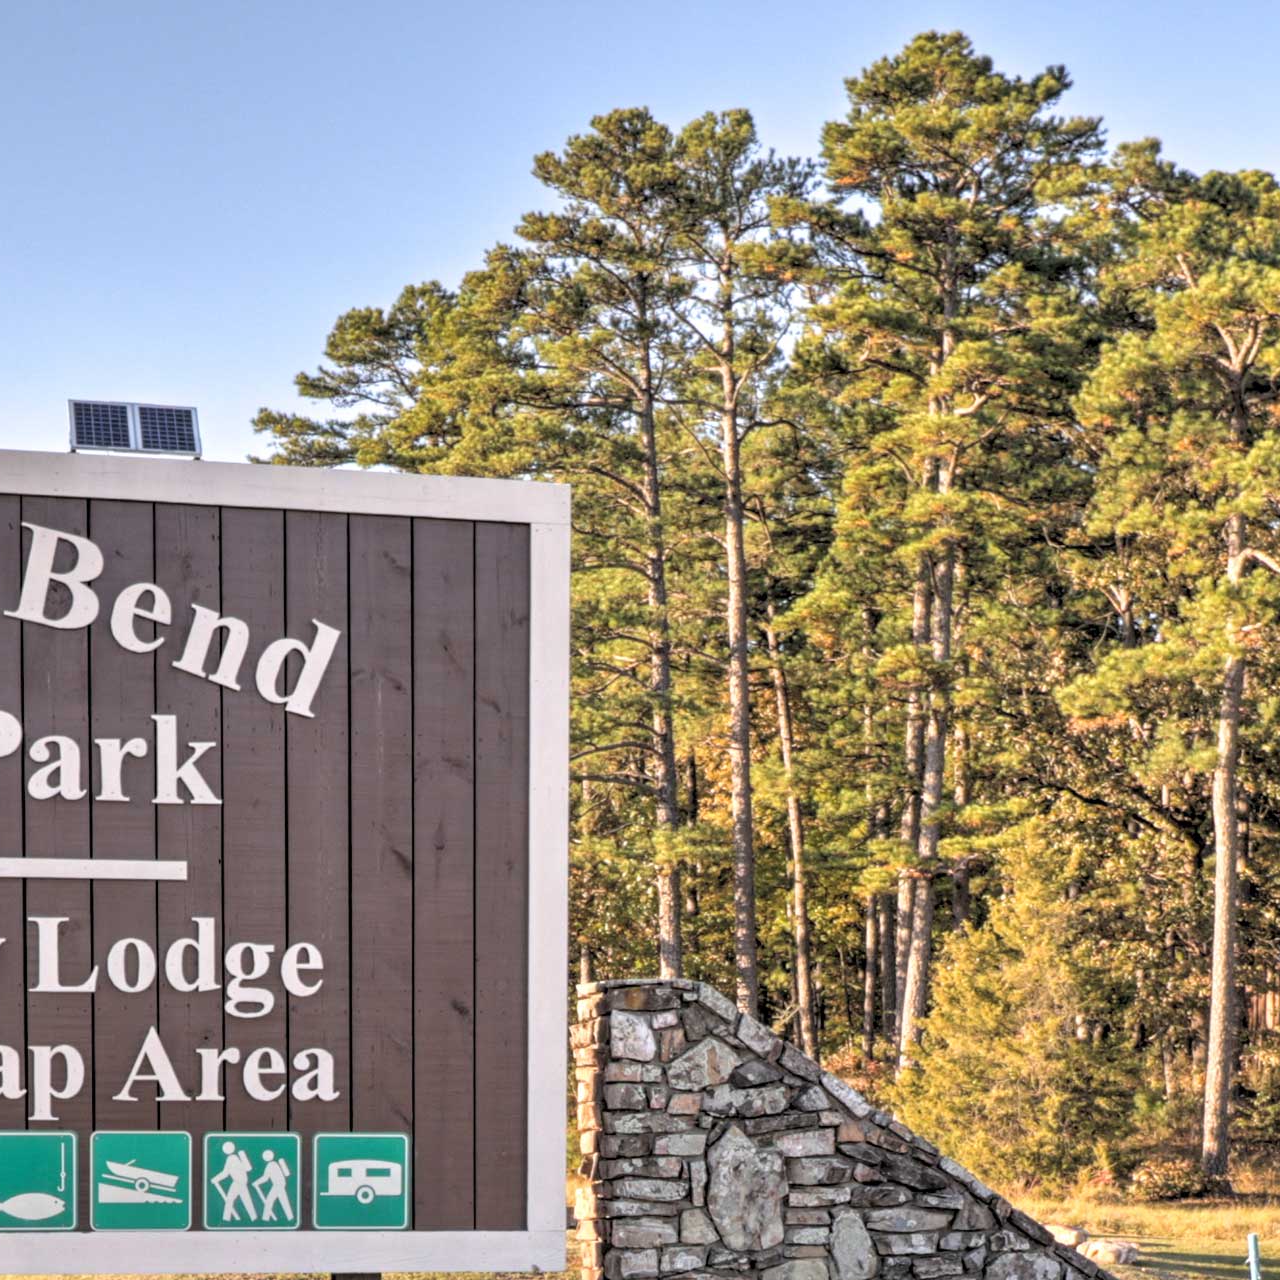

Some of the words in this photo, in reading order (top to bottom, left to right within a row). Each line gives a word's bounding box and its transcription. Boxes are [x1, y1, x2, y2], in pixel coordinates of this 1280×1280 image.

[3, 521, 341, 718] Bend
[27, 915, 324, 1018] Lodge
[112, 1026, 340, 1102] Area
